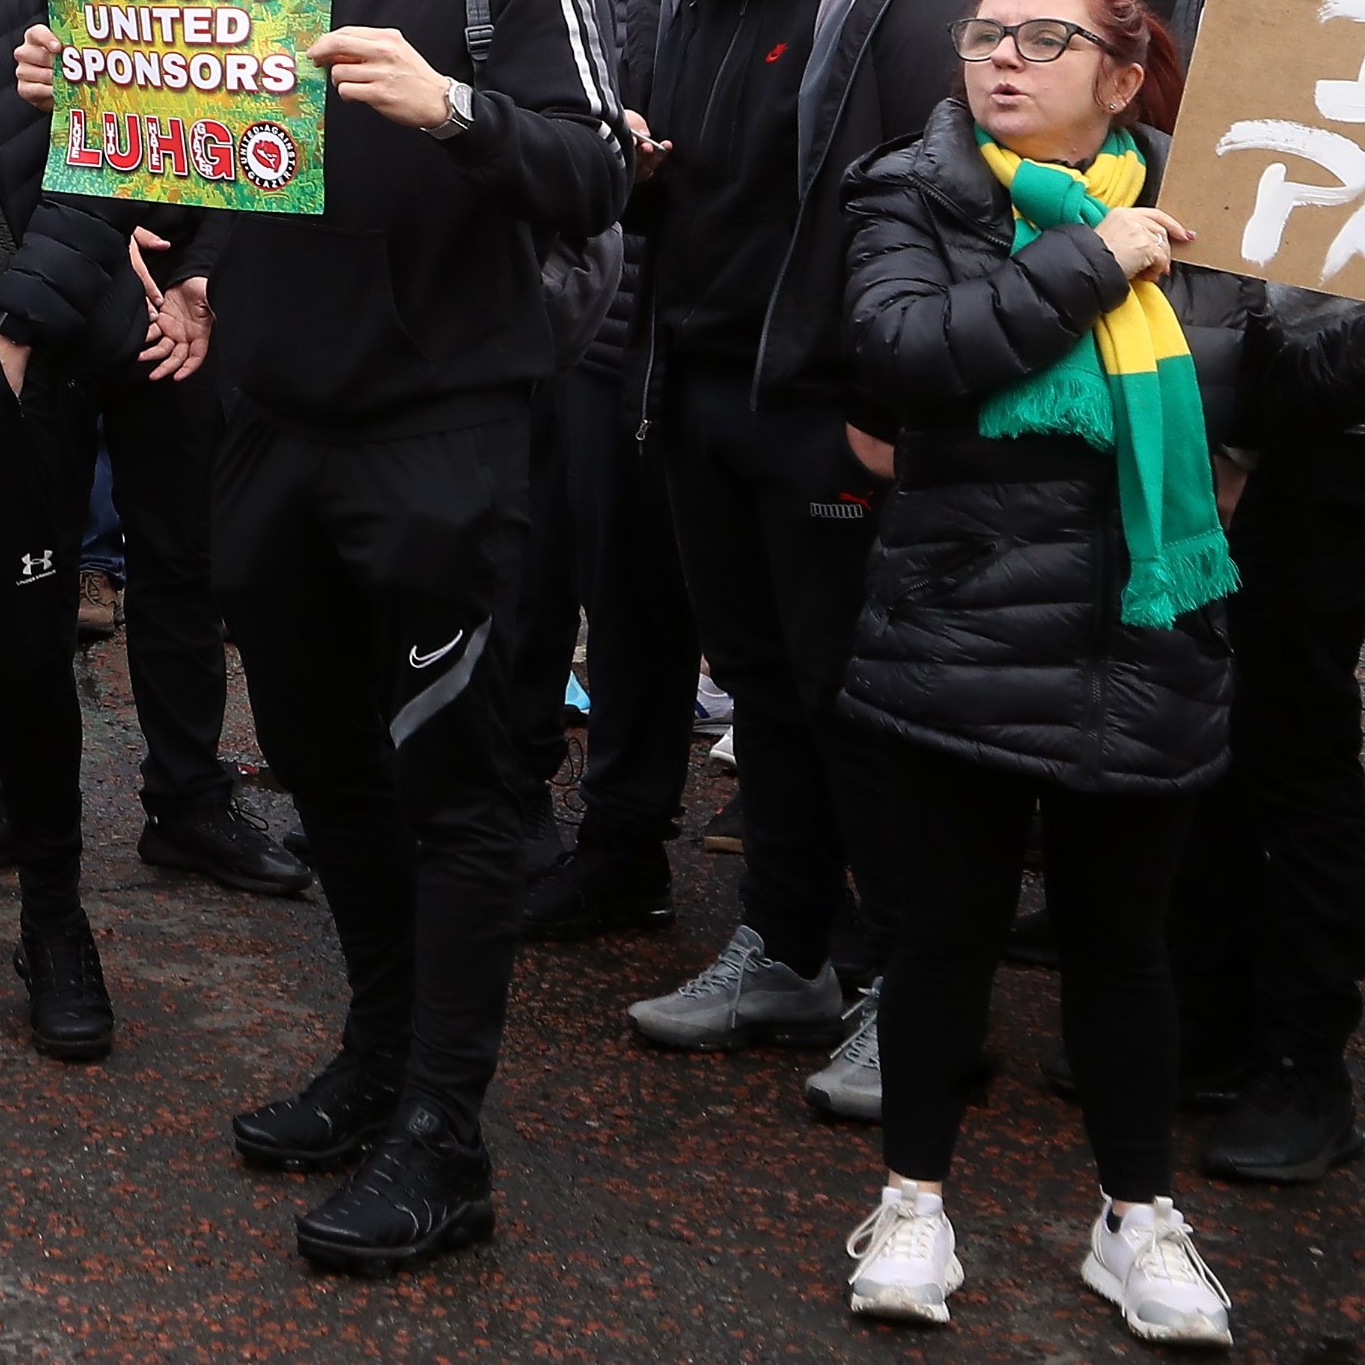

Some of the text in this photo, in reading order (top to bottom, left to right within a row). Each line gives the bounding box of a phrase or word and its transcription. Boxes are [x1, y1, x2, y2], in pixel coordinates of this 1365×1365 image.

[85, 5, 251, 45] UNITED
[62, 46, 296, 92] SPONSORS
[66, 108, 235, 180] LUHG
[71, 115, 81, 159] LOVE
[106, 122, 116, 155] UTD
[148, 122, 160, 166] HATE
[240, 124, 296, 166] UNITED AGAINST
[247, 170, 292, 189] GLAZER
